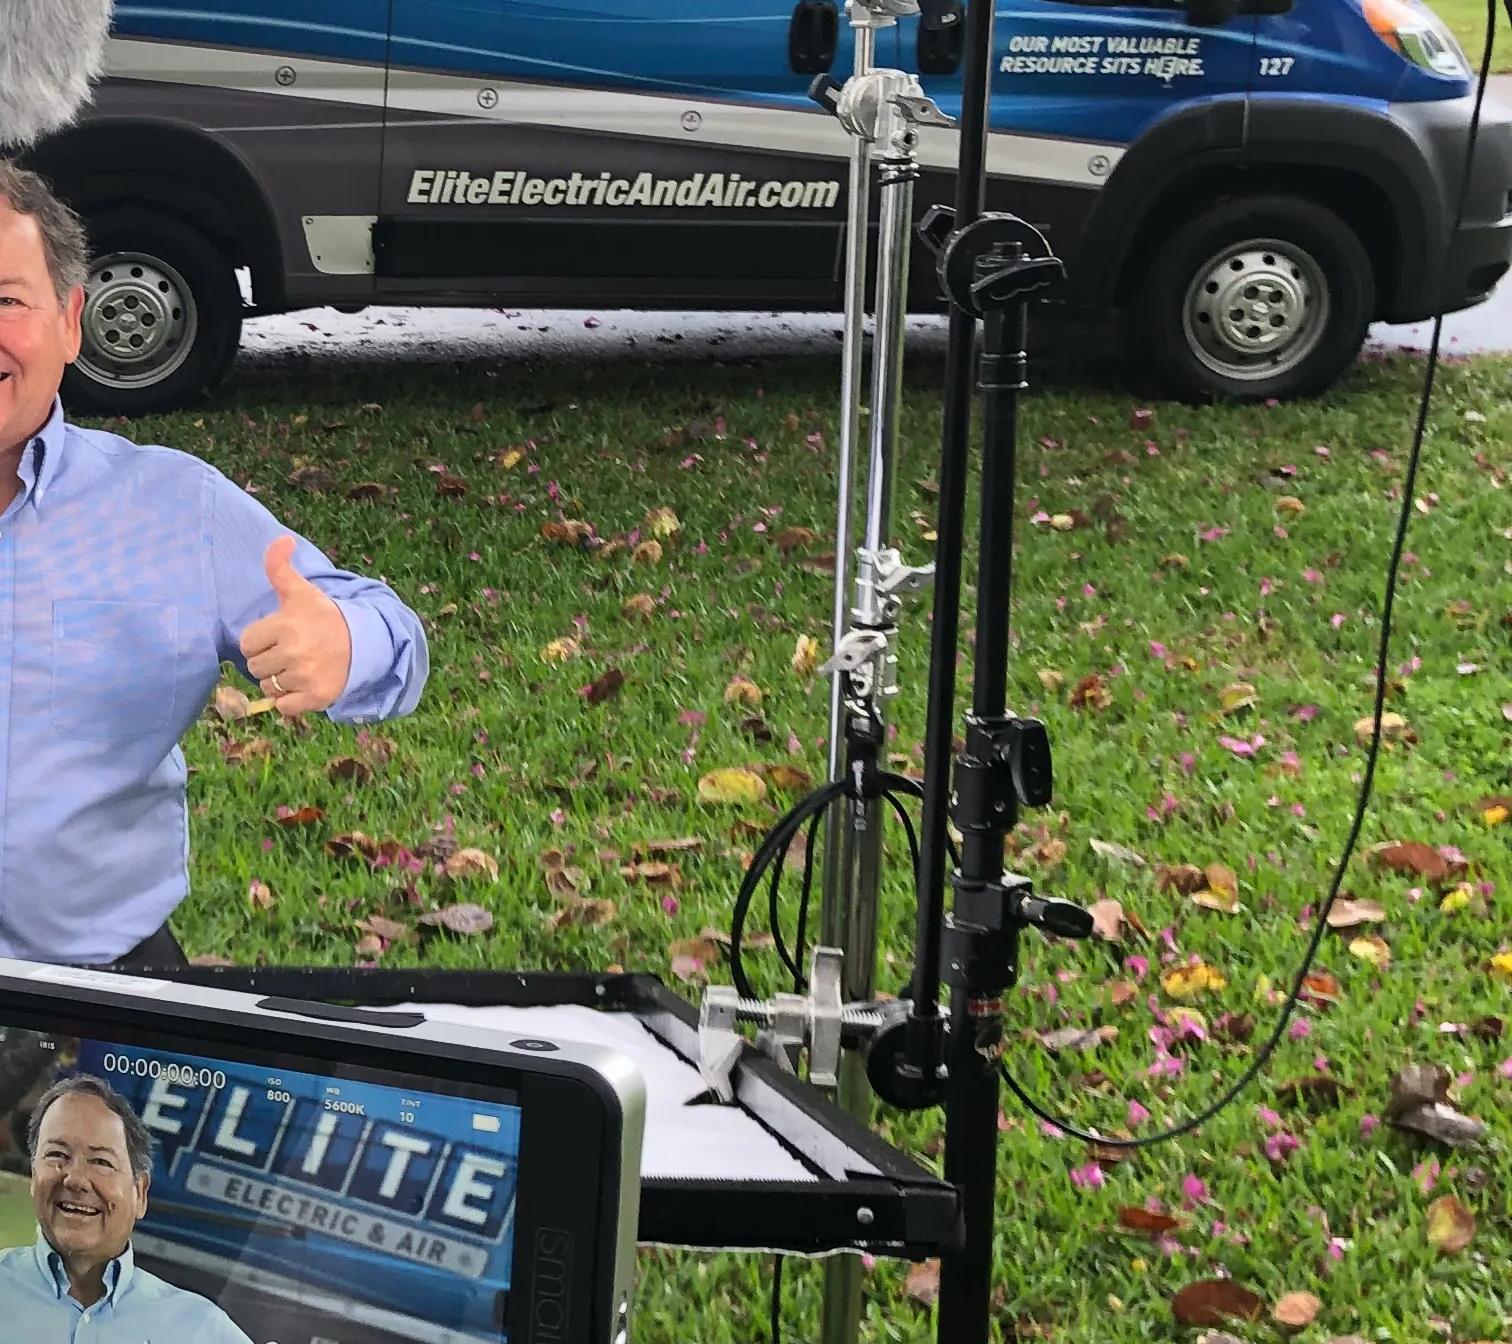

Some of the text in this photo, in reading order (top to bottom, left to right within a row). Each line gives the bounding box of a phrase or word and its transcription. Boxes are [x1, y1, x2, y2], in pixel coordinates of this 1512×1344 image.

[1008, 36, 1201, 55] OUR MOST VALUABLE
[999, 56, 1097, 74] RESOURCE
[1099, 57, 1141, 74] SITS
[1258, 58, 1295, 76] 127
[406, 169, 840, 208] EliteElectricAndAir.com
[103, 1053, 226, 1090] 00:00:00:00
[266, 1089, 291, 1103] 800
[324, 1099, 365, 1116] 5600K
[400, 1111, 414, 1123] 10
[142, 1078, 508, 1227] ELITE
[224, 1177, 447, 1264] ELECTRIC & AIR
